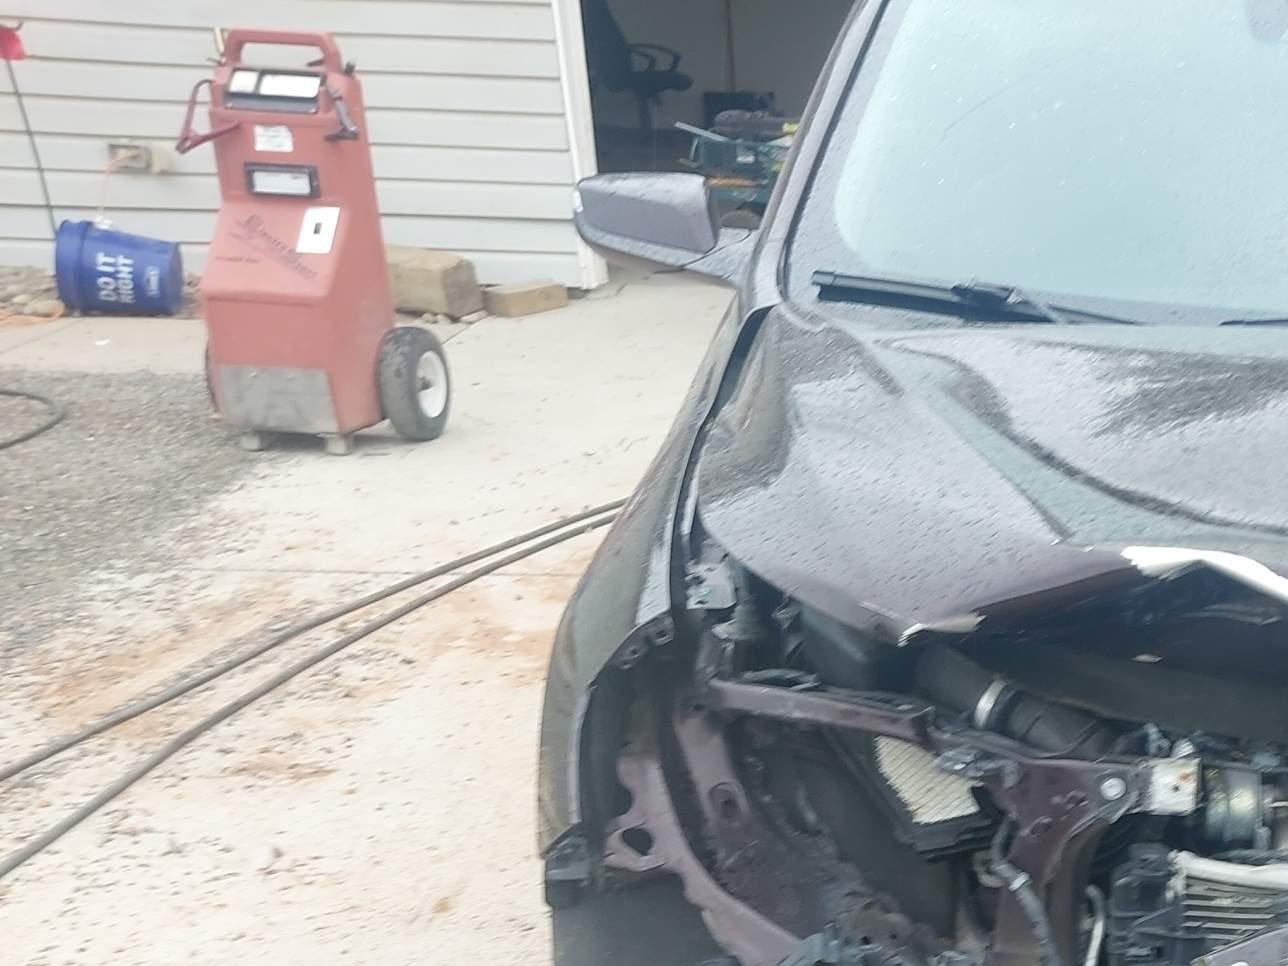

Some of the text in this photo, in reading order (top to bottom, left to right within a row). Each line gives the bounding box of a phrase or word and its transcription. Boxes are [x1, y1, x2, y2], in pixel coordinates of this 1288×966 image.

[96, 252, 117, 302] DO IT
[116, 255, 136, 304] RIGHT
